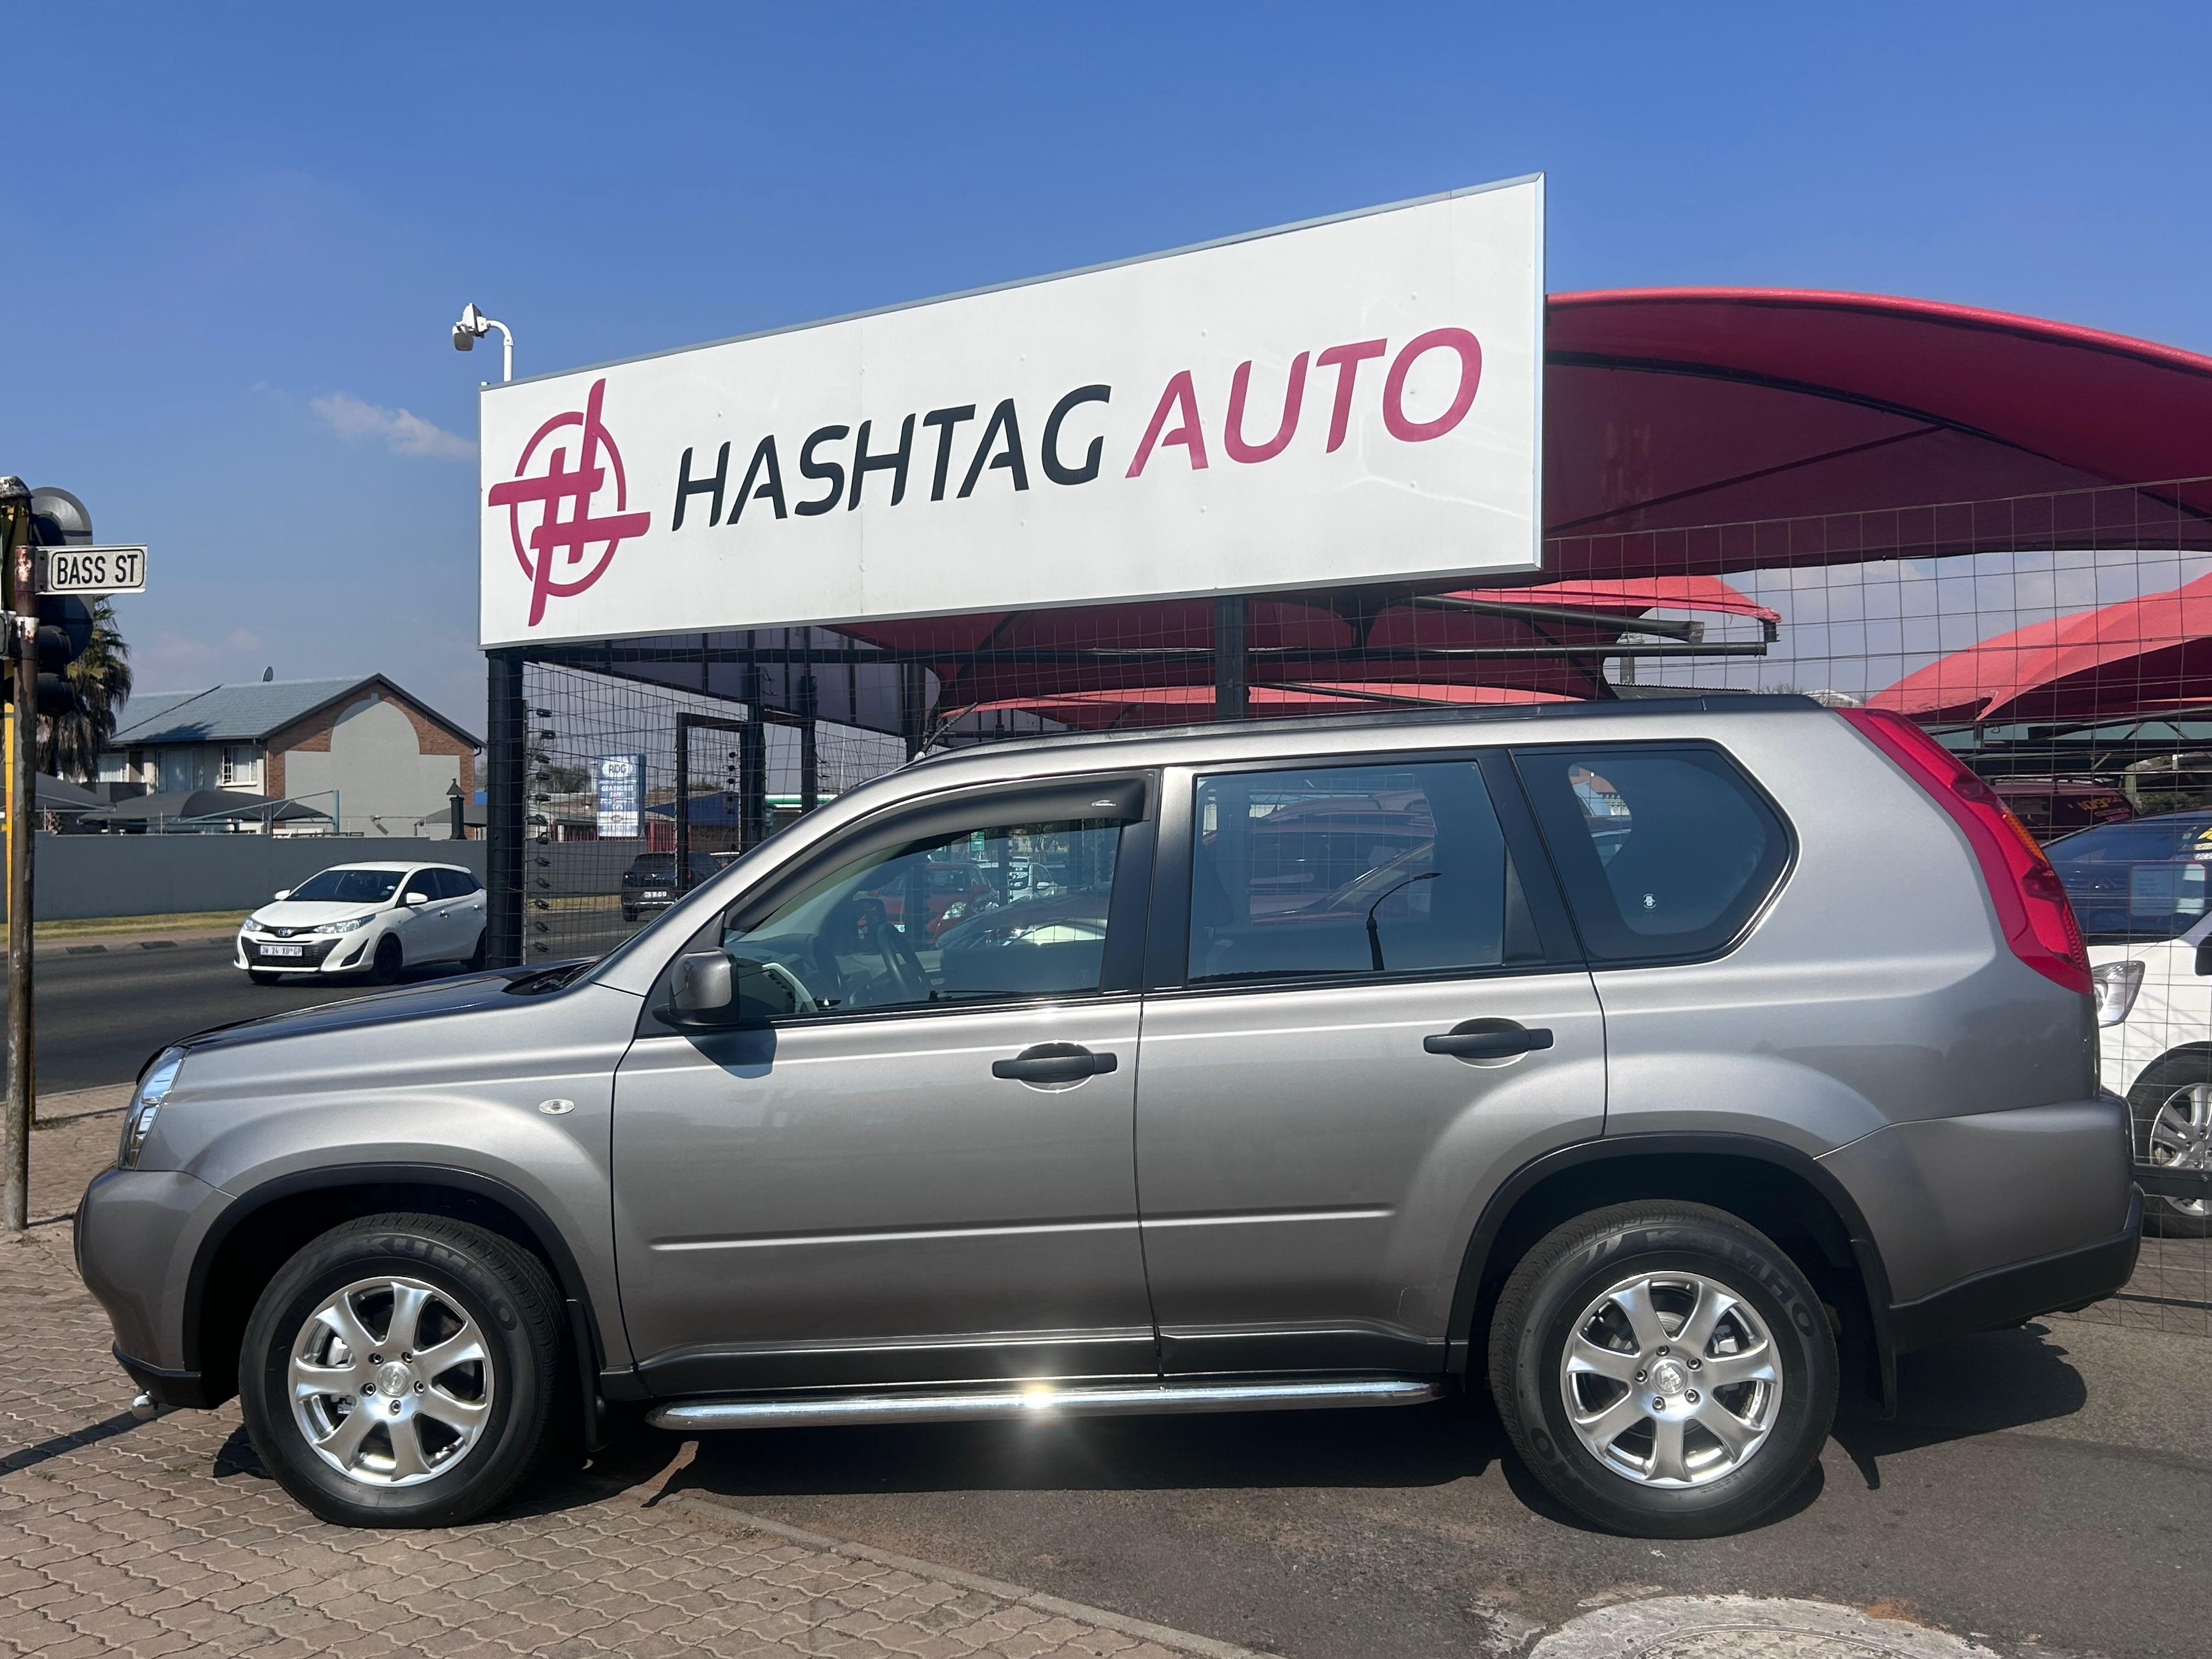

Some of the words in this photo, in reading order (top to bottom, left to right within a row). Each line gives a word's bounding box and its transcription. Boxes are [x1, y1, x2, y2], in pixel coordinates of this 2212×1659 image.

[672, 385, 1111, 532] HASHTAG
[1125, 327, 1482, 478] AUTO
[57, 556, 105, 584] BASS
[115, 555, 138, 583] ST
